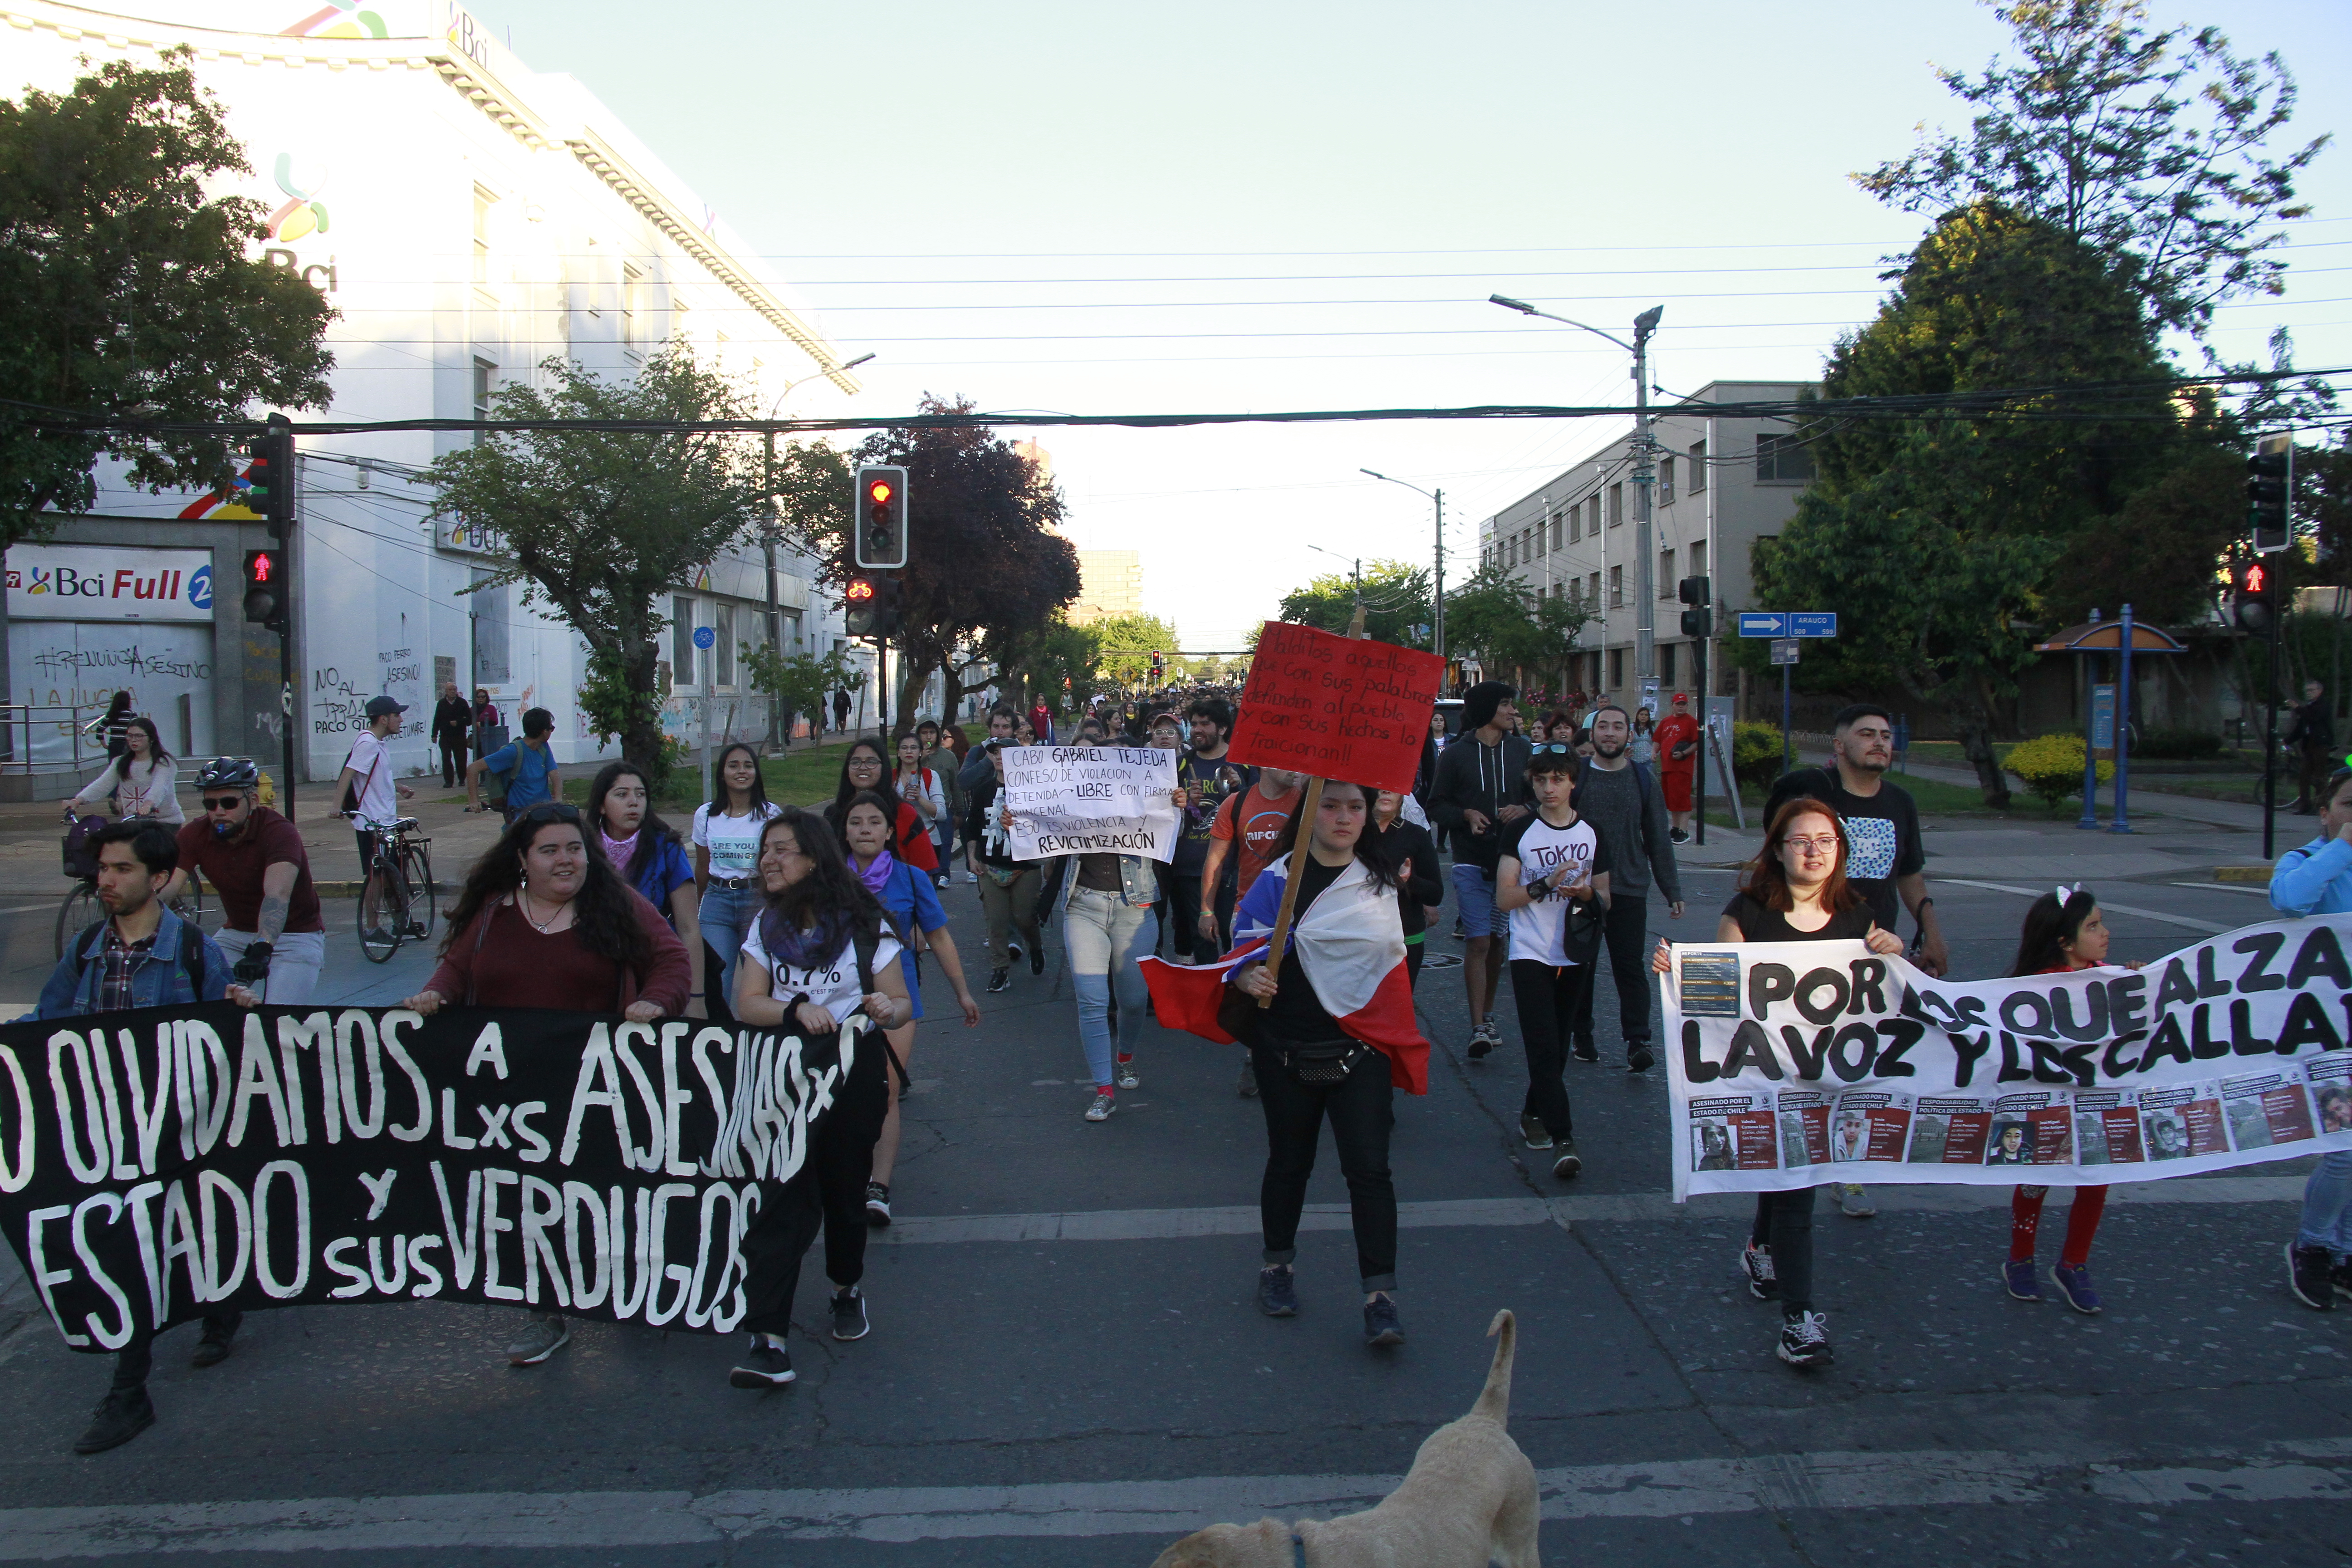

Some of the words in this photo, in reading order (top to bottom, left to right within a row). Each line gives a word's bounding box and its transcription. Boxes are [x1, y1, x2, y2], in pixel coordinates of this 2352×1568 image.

[463, 12, 486, 69] Bci
[265, 248, 338, 293] Bci
[56, 568, 104, 597] Bci
[112, 570, 181, 599] Full
[195, 576, 211, 602] 2
[379, 652, 392, 663] PACO
[394, 648, 411, 661] PERRO
[1260, 628, 1333, 662] Malditos
[1347, 652, 1417, 676] aquellos
[316, 667, 339, 691] NO
[387, 663, 421, 684] ASESINO!
[1284, 661, 1312, 681] con
[1322, 671, 1352, 693] sus
[1360, 674, 1436, 706] palabras
[338, 681, 368, 696] AL
[1324, 695, 1344, 715] al
[1348, 699, 1405, 726] pueblo
[316, 721, 346, 734] PACO
[1260, 710, 1290, 726] con
[1297, 713, 1328, 734] sus
[1338, 716, 1390, 740] hechos
[1401, 724, 1416, 746] lo
[1012, 750, 1043, 767] CABO
[1052, 747, 1107, 768] GABRIEL
[1113, 748, 1168, 768] TEJEDA
[1007, 768, 1058, 788] CONFESO
[1062, 768, 1074, 781] DE
[1078, 768, 1132, 780] VIOLACION
[1144, 770, 1152, 781] A
[1009, 789, 1059, 804] DETENIDA
[1076, 783, 1113, 797] LIBRE
[1120, 784, 1139, 797] CON
[1145, 785, 1174, 798] FIRMA
[1009, 804, 1070, 817] QUINCENAL
[1015, 819, 1040, 838] ESO
[1047, 821, 1062, 832] ES
[1063, 815, 1127, 831] VIOLENCIA
[1139, 815, 1147, 827] Y
[1038, 828, 1155, 854] REVICTIMIZACIÓN
[776, 962, 841, 986] 0.7%
[1748, 958, 1887, 1025] POR
[1896, 981, 1992, 1033] LOS
[1998, 973, 2147, 1042] QUE
[1681, 1019, 1784, 1083] LA
[1780, 1018, 1925, 1083] VOZ
[1946, 1030, 1991, 1088] Y
[2225, 1075, 2280, 1089] RESPONSABILIDAD
[2265, 1083, 2289, 1092] ESTADO
[48, 1009, 432, 1184] OLVIDAMOS
[466, 1022, 509, 1080] A
[1693, 1098, 1729, 1107] ASESINADO
[1999, 1094, 2029, 1103] ASESINADO
[358, 1168, 397, 1220] Y
[29, 1159, 311, 1350] ESTADO
[429, 1161, 762, 1333] VERDUGOS
[323, 1233, 443, 1298] SUS
